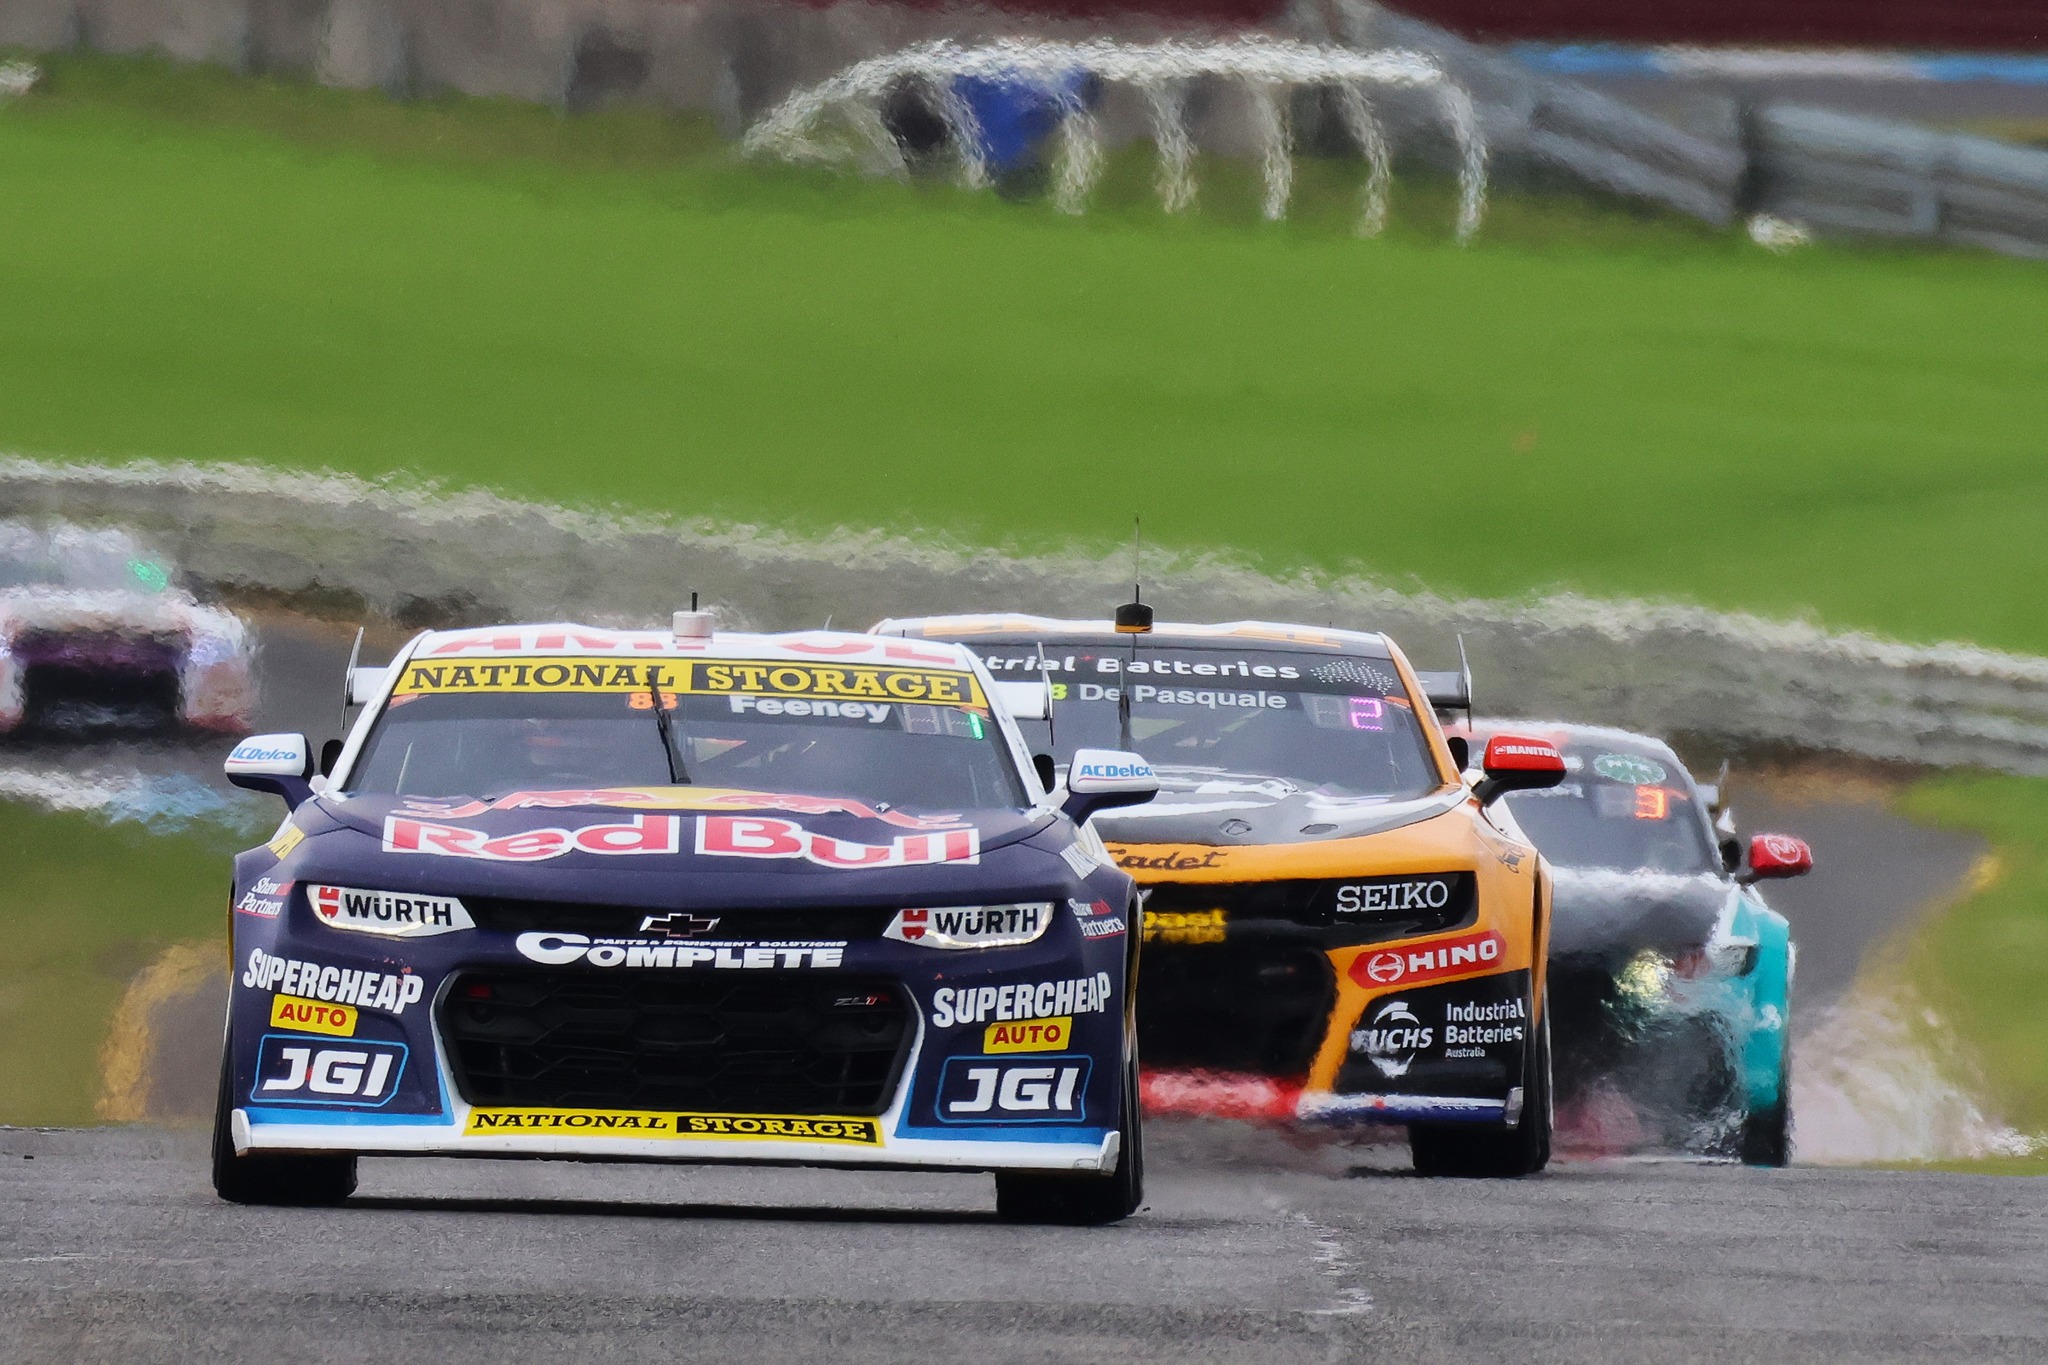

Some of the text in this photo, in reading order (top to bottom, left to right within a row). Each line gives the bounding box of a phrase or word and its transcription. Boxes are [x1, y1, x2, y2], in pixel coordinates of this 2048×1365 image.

[409, 664, 961, 702] NATIONAL STORAGE
[1097, 658, 1299, 679] Batteries
[628, 692, 680, 710] 88
[729, 695, 891, 723] Feeney
[1079, 684, 1121, 702] De
[1134, 685, 1287, 710] Pasquale
[1350, 697, 1383, 731] 2
[387, 814, 976, 866] Red Bull
[344, 893, 453, 927] WÜRTH
[1336, 880, 1449, 914] SEIKO
[935, 908, 1038, 936] WÜRTH
[515, 932, 845, 969] COMPLETE
[1408, 938, 1498, 972] HINO
[242, 947, 424, 1015] SUPERCHEAP
[932, 971, 1112, 1029] SUPERCHEAP
[1446, 998, 1525, 1023] Industrial
[279, 1003, 347, 1029] AUTO
[992, 1025, 1061, 1046] AUTO
[1446, 1024, 1523, 1045] Batteries
[1445, 1047, 1486, 1059] Australia
[262, 1047, 394, 1098] JGI
[949, 1067, 1080, 1112] JGI
[473, 1113, 867, 1140] NATIONAL STORAGE
